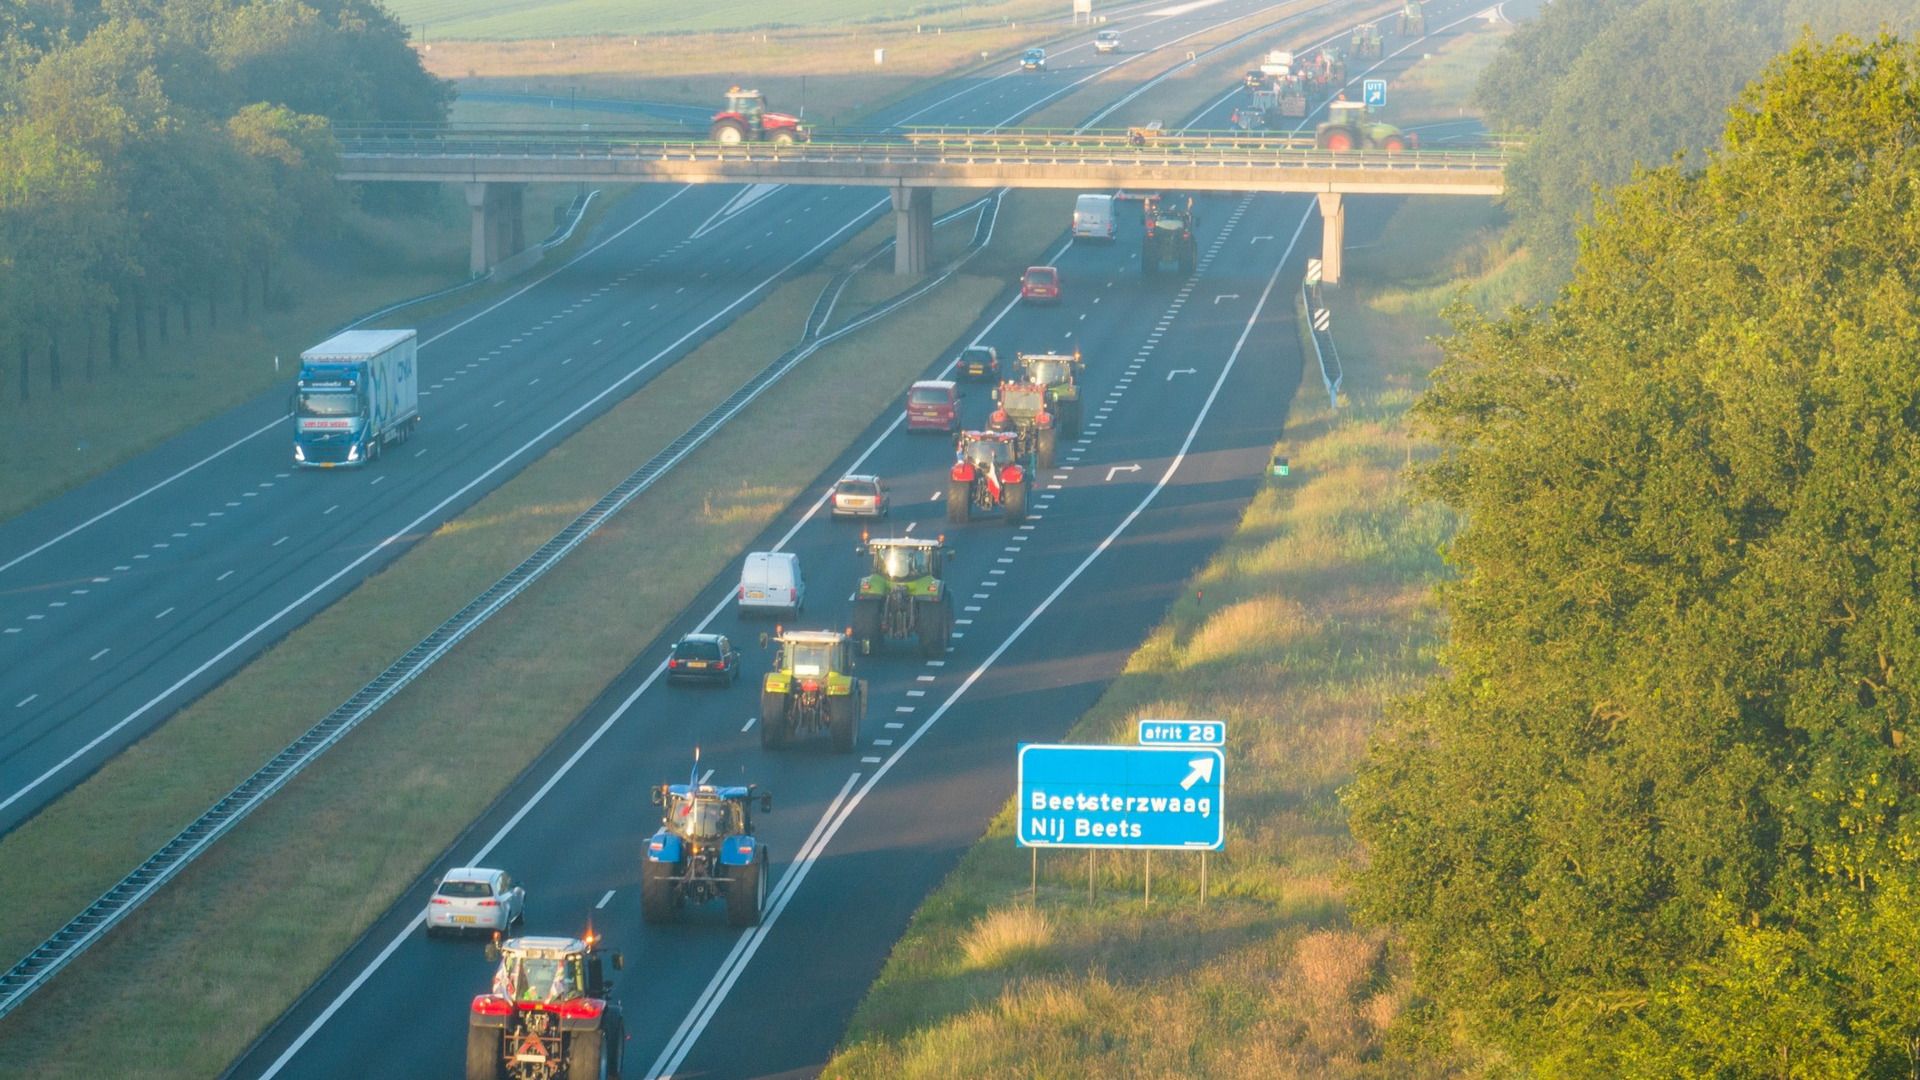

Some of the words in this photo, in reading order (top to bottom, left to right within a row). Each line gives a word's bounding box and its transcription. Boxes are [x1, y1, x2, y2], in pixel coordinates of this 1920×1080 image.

[1368, 83, 1382, 91] UIT
[1145, 726, 1182, 739] afrit
[1188, 726, 1216, 741] 28
[1031, 792, 1211, 819] Beetsterzwaag
[1031, 817, 1065, 842] Nij
[1075, 818, 1142, 838] Beets
